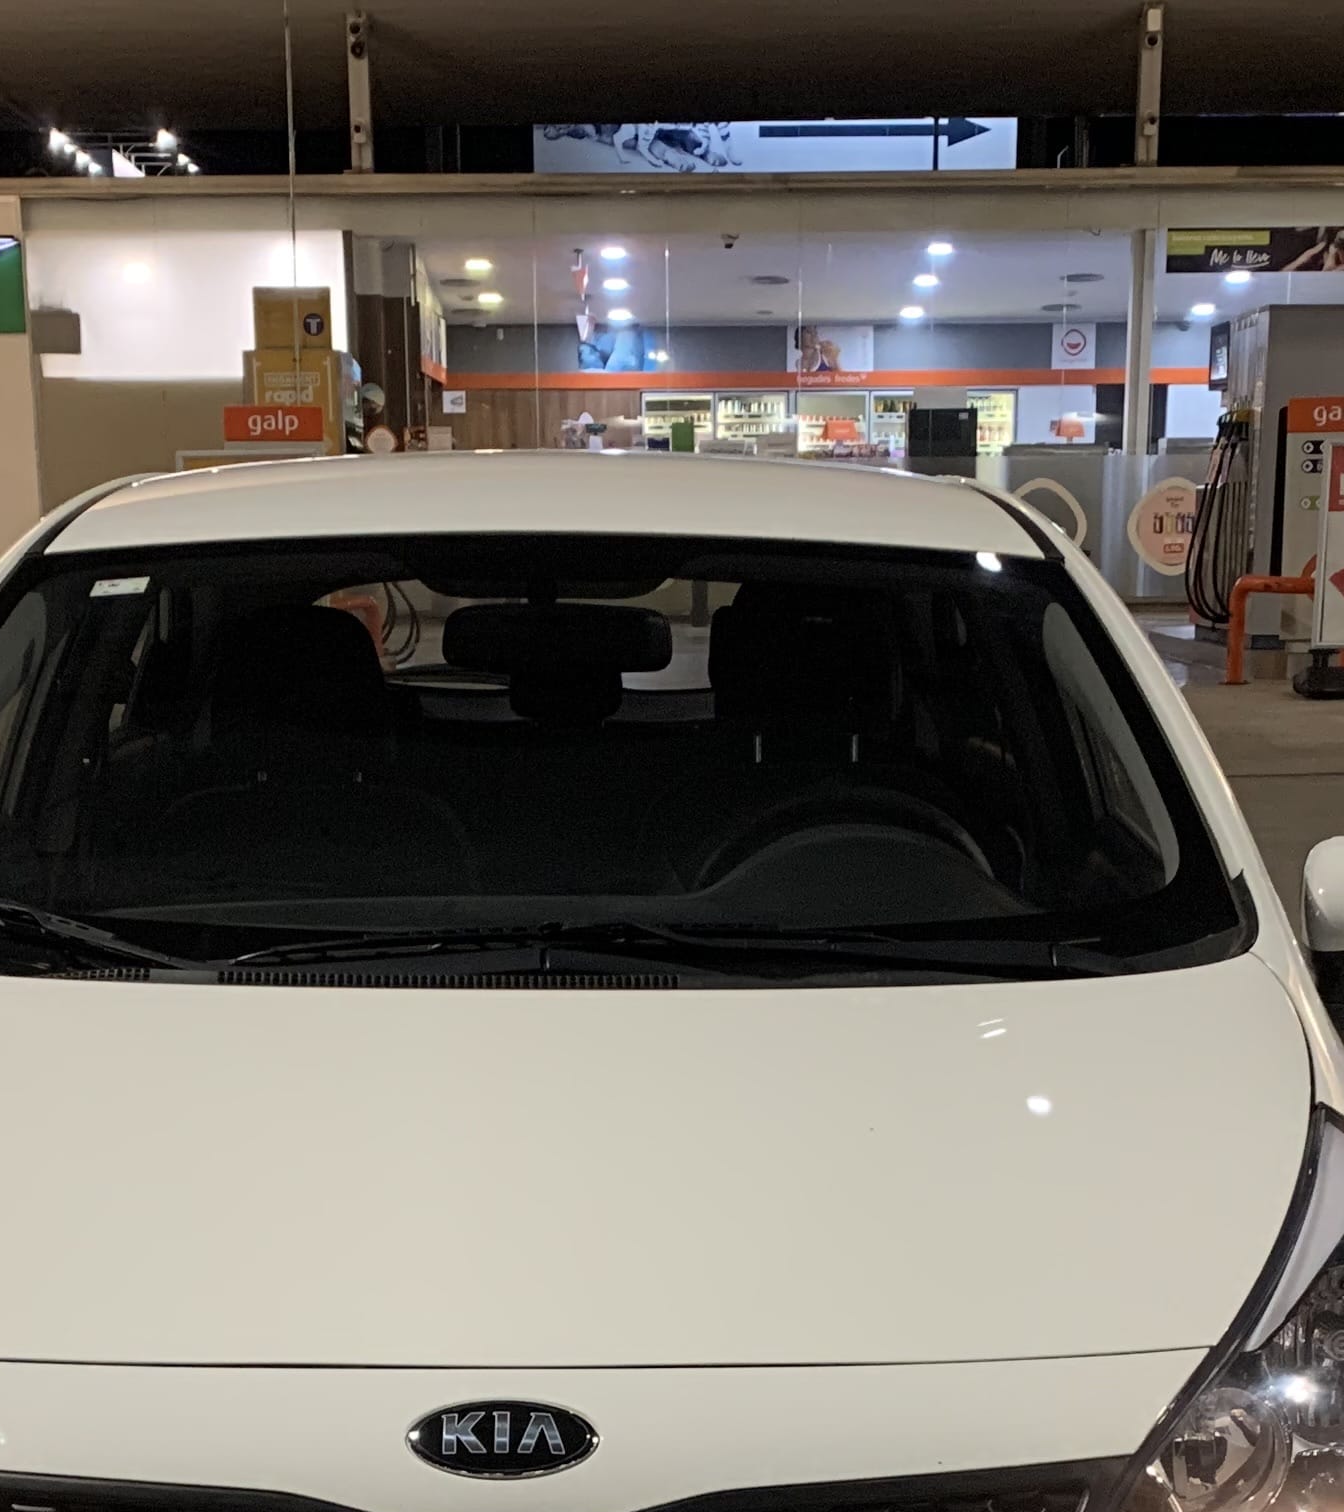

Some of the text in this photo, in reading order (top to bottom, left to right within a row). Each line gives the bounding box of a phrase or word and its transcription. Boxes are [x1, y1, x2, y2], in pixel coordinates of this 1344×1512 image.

[1209, 247, 1229, 267] Me
[306, 318, 321, 335] T
[247, 409, 299, 436] galp
[441, 1411, 566, 1455] KIA
